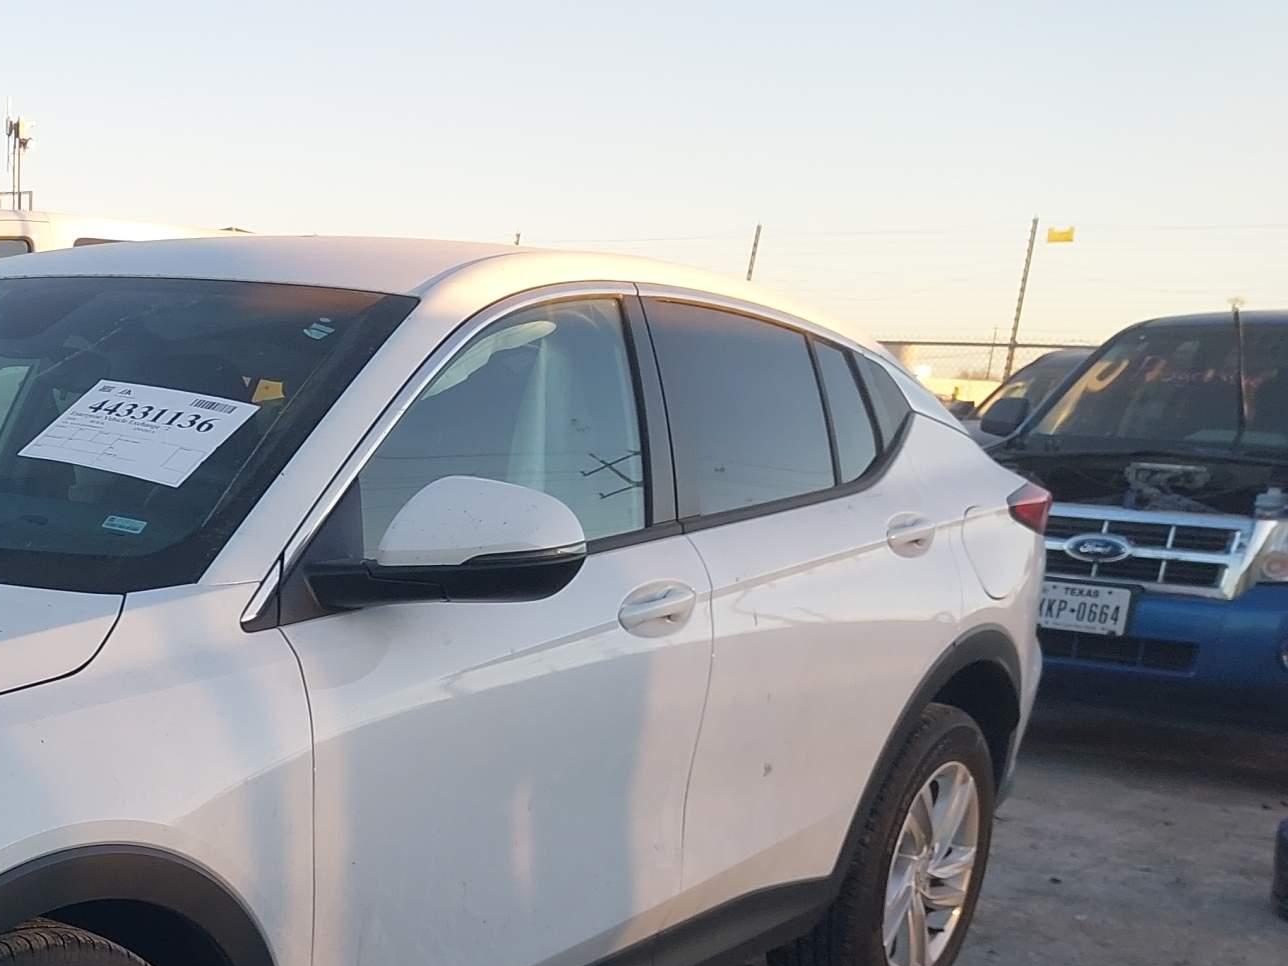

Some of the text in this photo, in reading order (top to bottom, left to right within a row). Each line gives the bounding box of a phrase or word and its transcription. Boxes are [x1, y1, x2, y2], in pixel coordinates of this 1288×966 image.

[88, 398, 221, 434] 44331136
[104, 415, 128, 424] Vehicle
[1079, 542, 1112, 554] Ford
[1065, 587, 1099, 598] TEXAS
